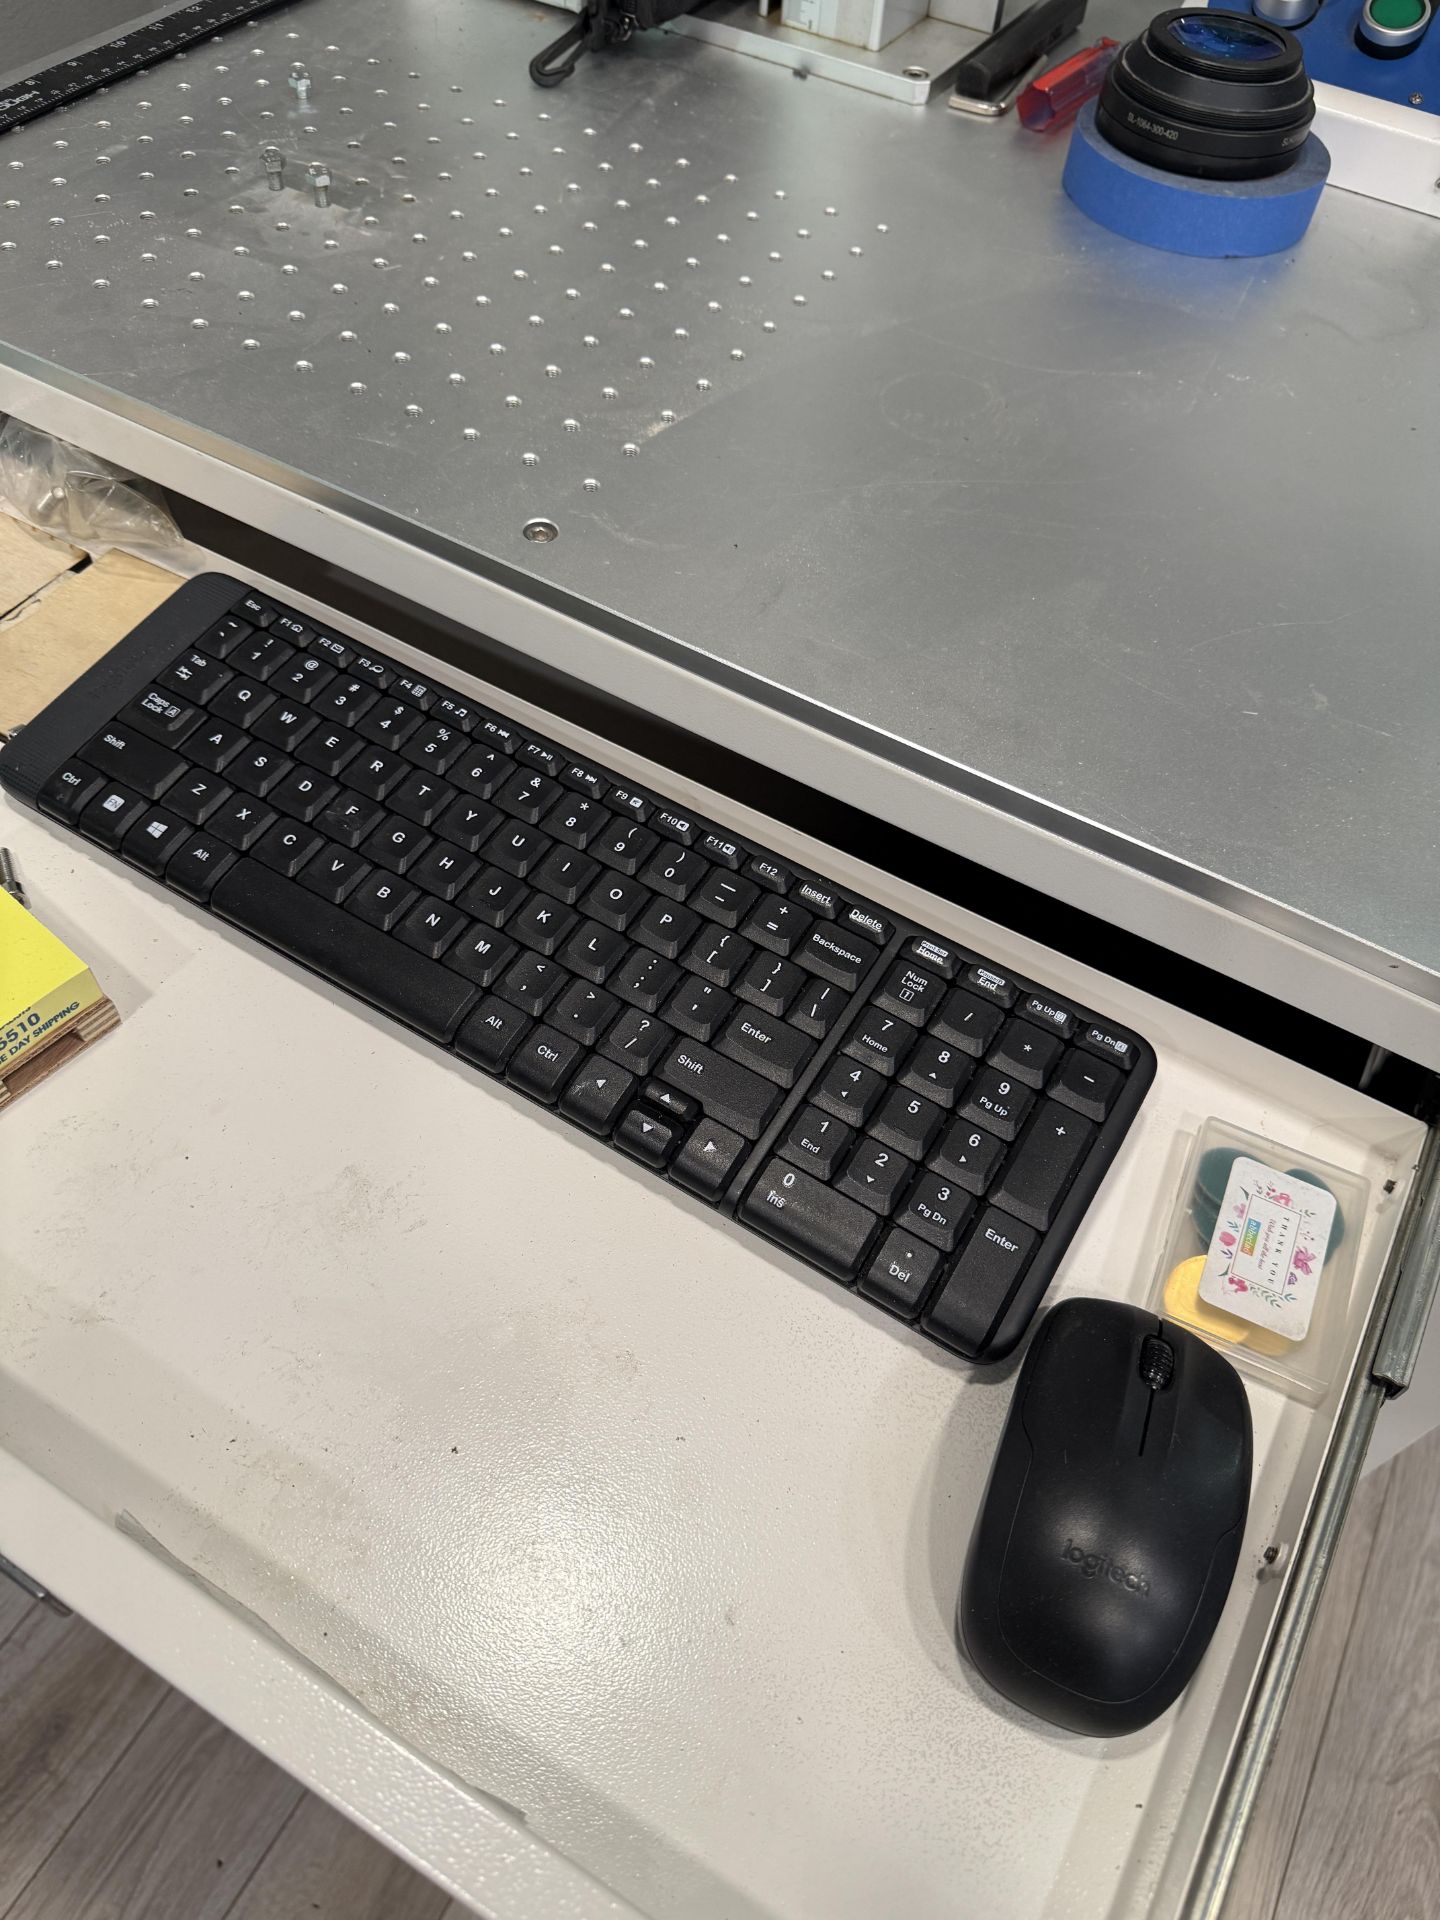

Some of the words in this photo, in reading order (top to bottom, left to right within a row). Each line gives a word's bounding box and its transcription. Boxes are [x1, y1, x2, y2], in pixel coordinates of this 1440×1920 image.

[110, 41, 127, 49] 10
[246, 600, 261, 610] Esc
[280, 618, 292, 628] F1
[319, 637, 331, 648] F2
[191, 654, 207, 667] Tab
[358, 656, 370, 667] F3
[292, 674, 303, 682] 2
[401, 679, 411, 689] F4
[148, 691, 171, 708] Caps
[239, 690, 251, 701] Q
[335, 696, 346, 705] 3
[141, 698, 164, 715] Lock
[442, 700, 454, 710] F5
[281, 712, 296, 723] W
[484, 722, 497, 733] F6
[104, 735, 125, 749] Shift
[210, 735, 222, 744] A
[326, 737, 339, 747] E
[425, 744, 437, 752] 5
[527, 745, 541, 754] F7
[255, 757, 267, 766] S
[370, 761, 383, 771] R
[472, 768, 482, 776] 6
[572, 768, 583, 777] F8
[63, 773, 81, 785] Ctrl
[192, 784, 206, 795] Z
[299, 781, 312, 791] D
[419, 786, 430, 795] T
[519, 791, 529, 800] 7
[616, 790, 628, 800] F9
[236, 809, 251, 820] X
[346, 806, 359, 814] F
[466, 811, 477, 820] Y
[566, 817, 576, 826] 8
[660, 813, 677, 825] F10
[284, 835, 296, 844] C
[393, 832, 405, 842] G
[512, 835, 525, 846] U
[707, 835, 723, 848] F11
[615, 842, 625, 851] 9
[193, 849, 209, 861] Alt
[332, 860, 344, 871] V
[439, 857, 454, 869] H
[665, 868, 674, 877] 0
[760, 863, 777, 876] F12
[377, 887, 390, 897] B
[489, 887, 501, 895] J
[610, 889, 622, 899] O
[801, 884, 832, 903] Insert
[426, 914, 440, 926] N
[537, 911, 551, 923] K
[660, 914, 672, 923] P
[850, 909, 883, 931] Delete
[475, 941, 491, 953] M
[588, 939, 596, 950] L
[813, 934, 861, 963] Backspace
[917, 946, 943, 965] Home
[905, 970, 928, 986] Num
[978, 977, 998, 990] End
[901, 977, 925, 992] Lock
[1031, 999, 1044, 1012] Pg
[1043, 1005, 1055, 1016] Up
[485, 1016, 502, 1029] Alt
[882, 1020, 893, 1030] 7
[9, 1035, 30, 1056] DAY
[32, 1001, 80, 1038] SHIPPING
[741, 1023, 771, 1042] Enter
[862, 1035, 887, 1052] Home
[1091, 1030, 1104, 1042] Pg
[1103, 1034, 1116, 1046] Dn
[538, 1046, 558, 1061] Ctrl
[939, 1051, 950, 1063] 8
[678, 1055, 703, 1074] Shift
[850, 1071, 861, 1081] 4
[999, 1083, 1010, 1094] 9
[908, 1101, 920, 1113] 5
[980, 1097, 992, 1109] Pg
[994, 1105, 1007, 1115] Up
[821, 1122, 829, 1132] 1
[801, 1138, 820, 1153] End
[969, 1134, 980, 1146] 6
[875, 1153, 888, 1167] 2
[783, 1173, 795, 1187] 0
[767, 1191, 786, 1208] Ins
[938, 1188, 949, 1200] 3
[918, 1203, 934, 1219] Pg
[932, 1212, 946, 1224] Dn
[986, 1228, 1018, 1251] Enter
[889, 1263, 910, 1283] Del
[1060, 1538, 1151, 1598] logitech
